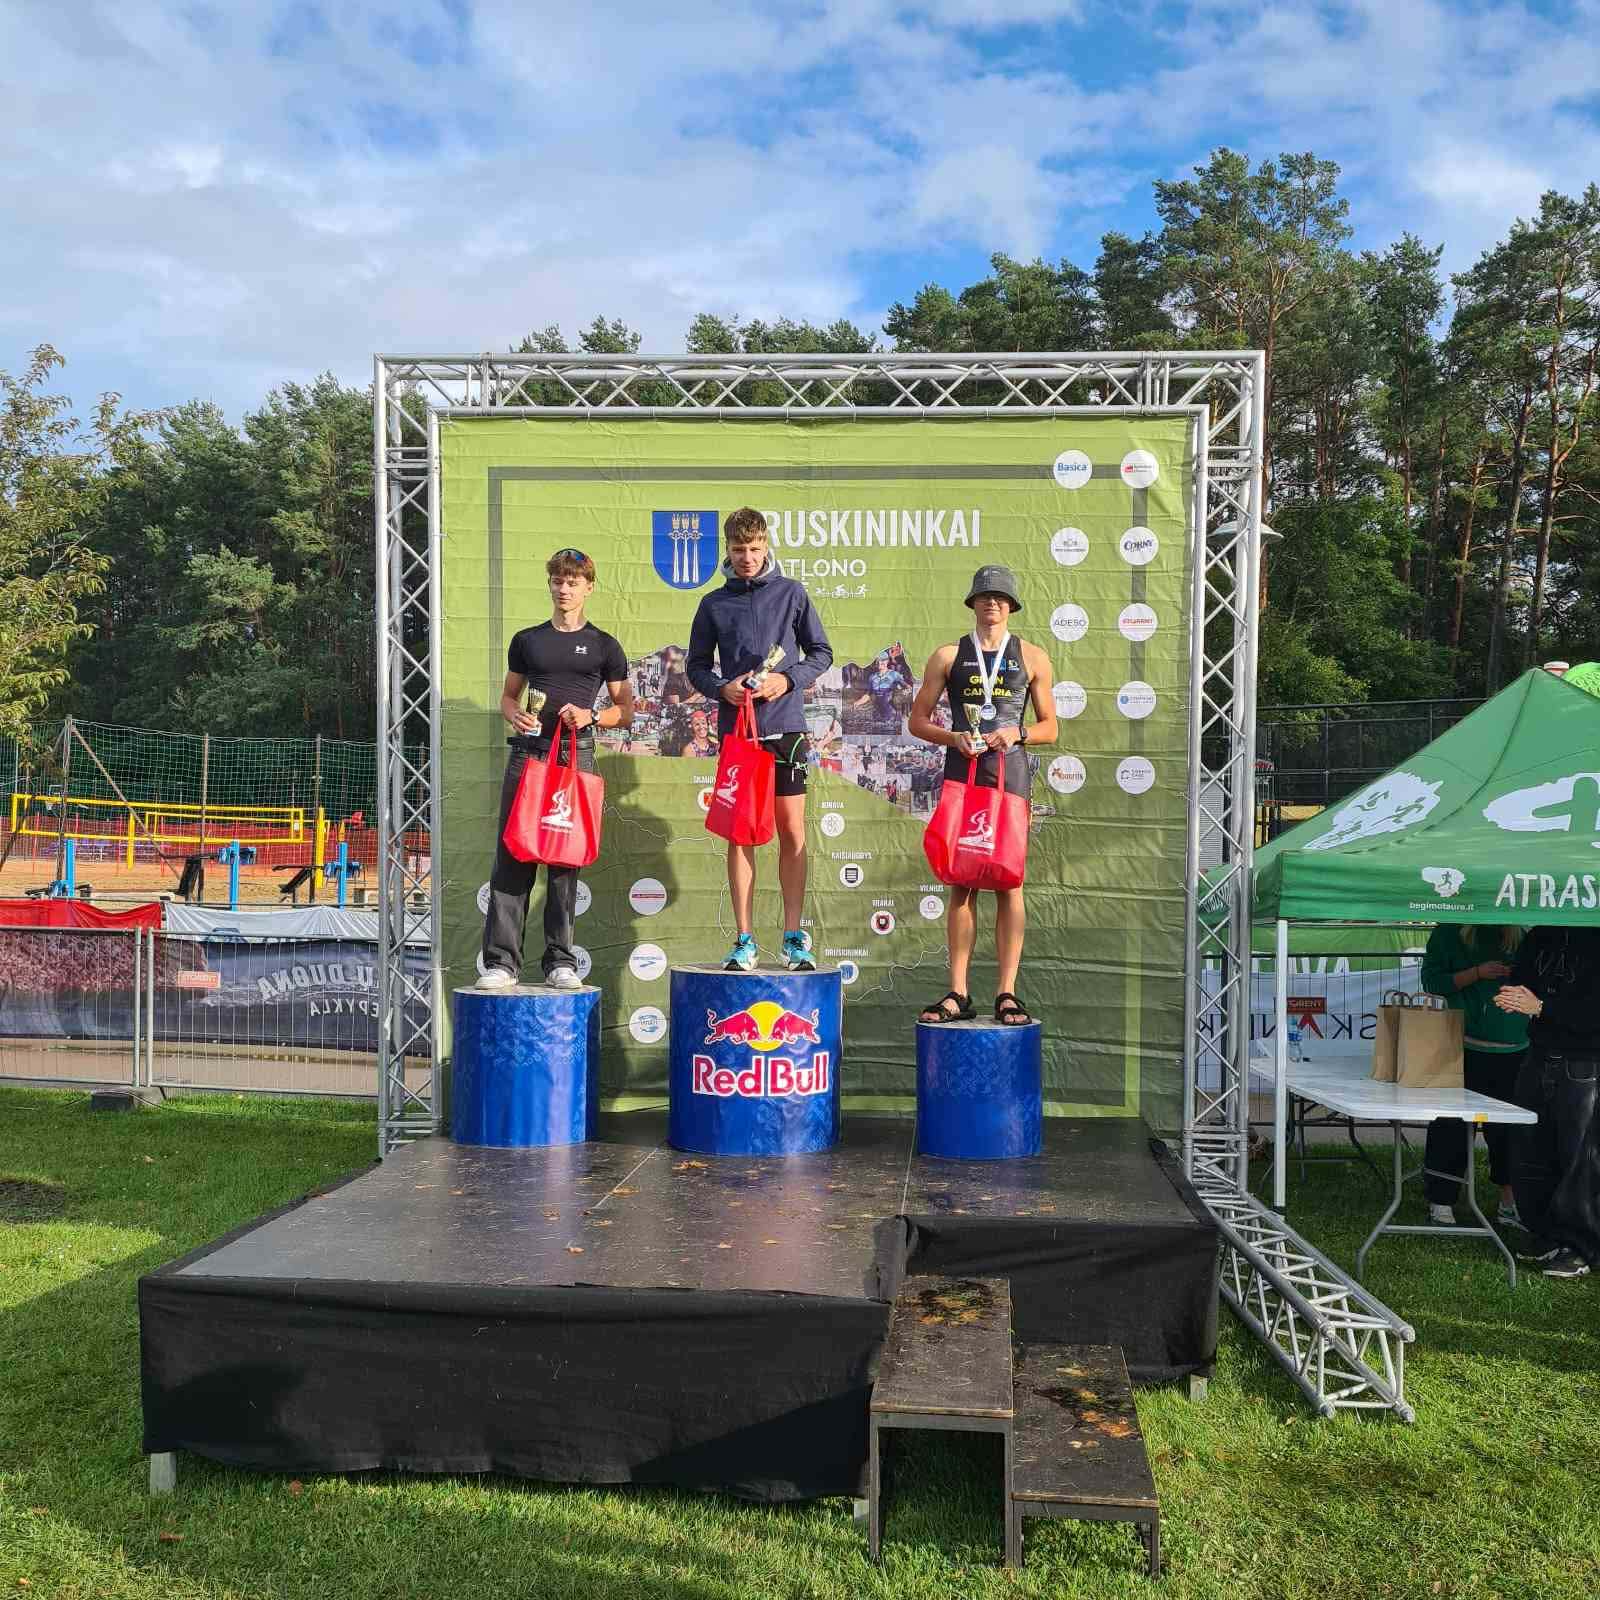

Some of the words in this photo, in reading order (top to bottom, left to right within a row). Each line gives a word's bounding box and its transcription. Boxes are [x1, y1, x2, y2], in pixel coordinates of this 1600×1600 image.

[1057, 461, 1088, 472] Basica
[760, 510, 981, 548] RUSKININKAI
[775, 559, 866, 577] TLONO
[969, 674, 1004, 685] GN
[1495, 873, 1600, 909] ATRAS
[693, 1055, 765, 1096] Red
[768, 1052, 829, 1096] Bull
